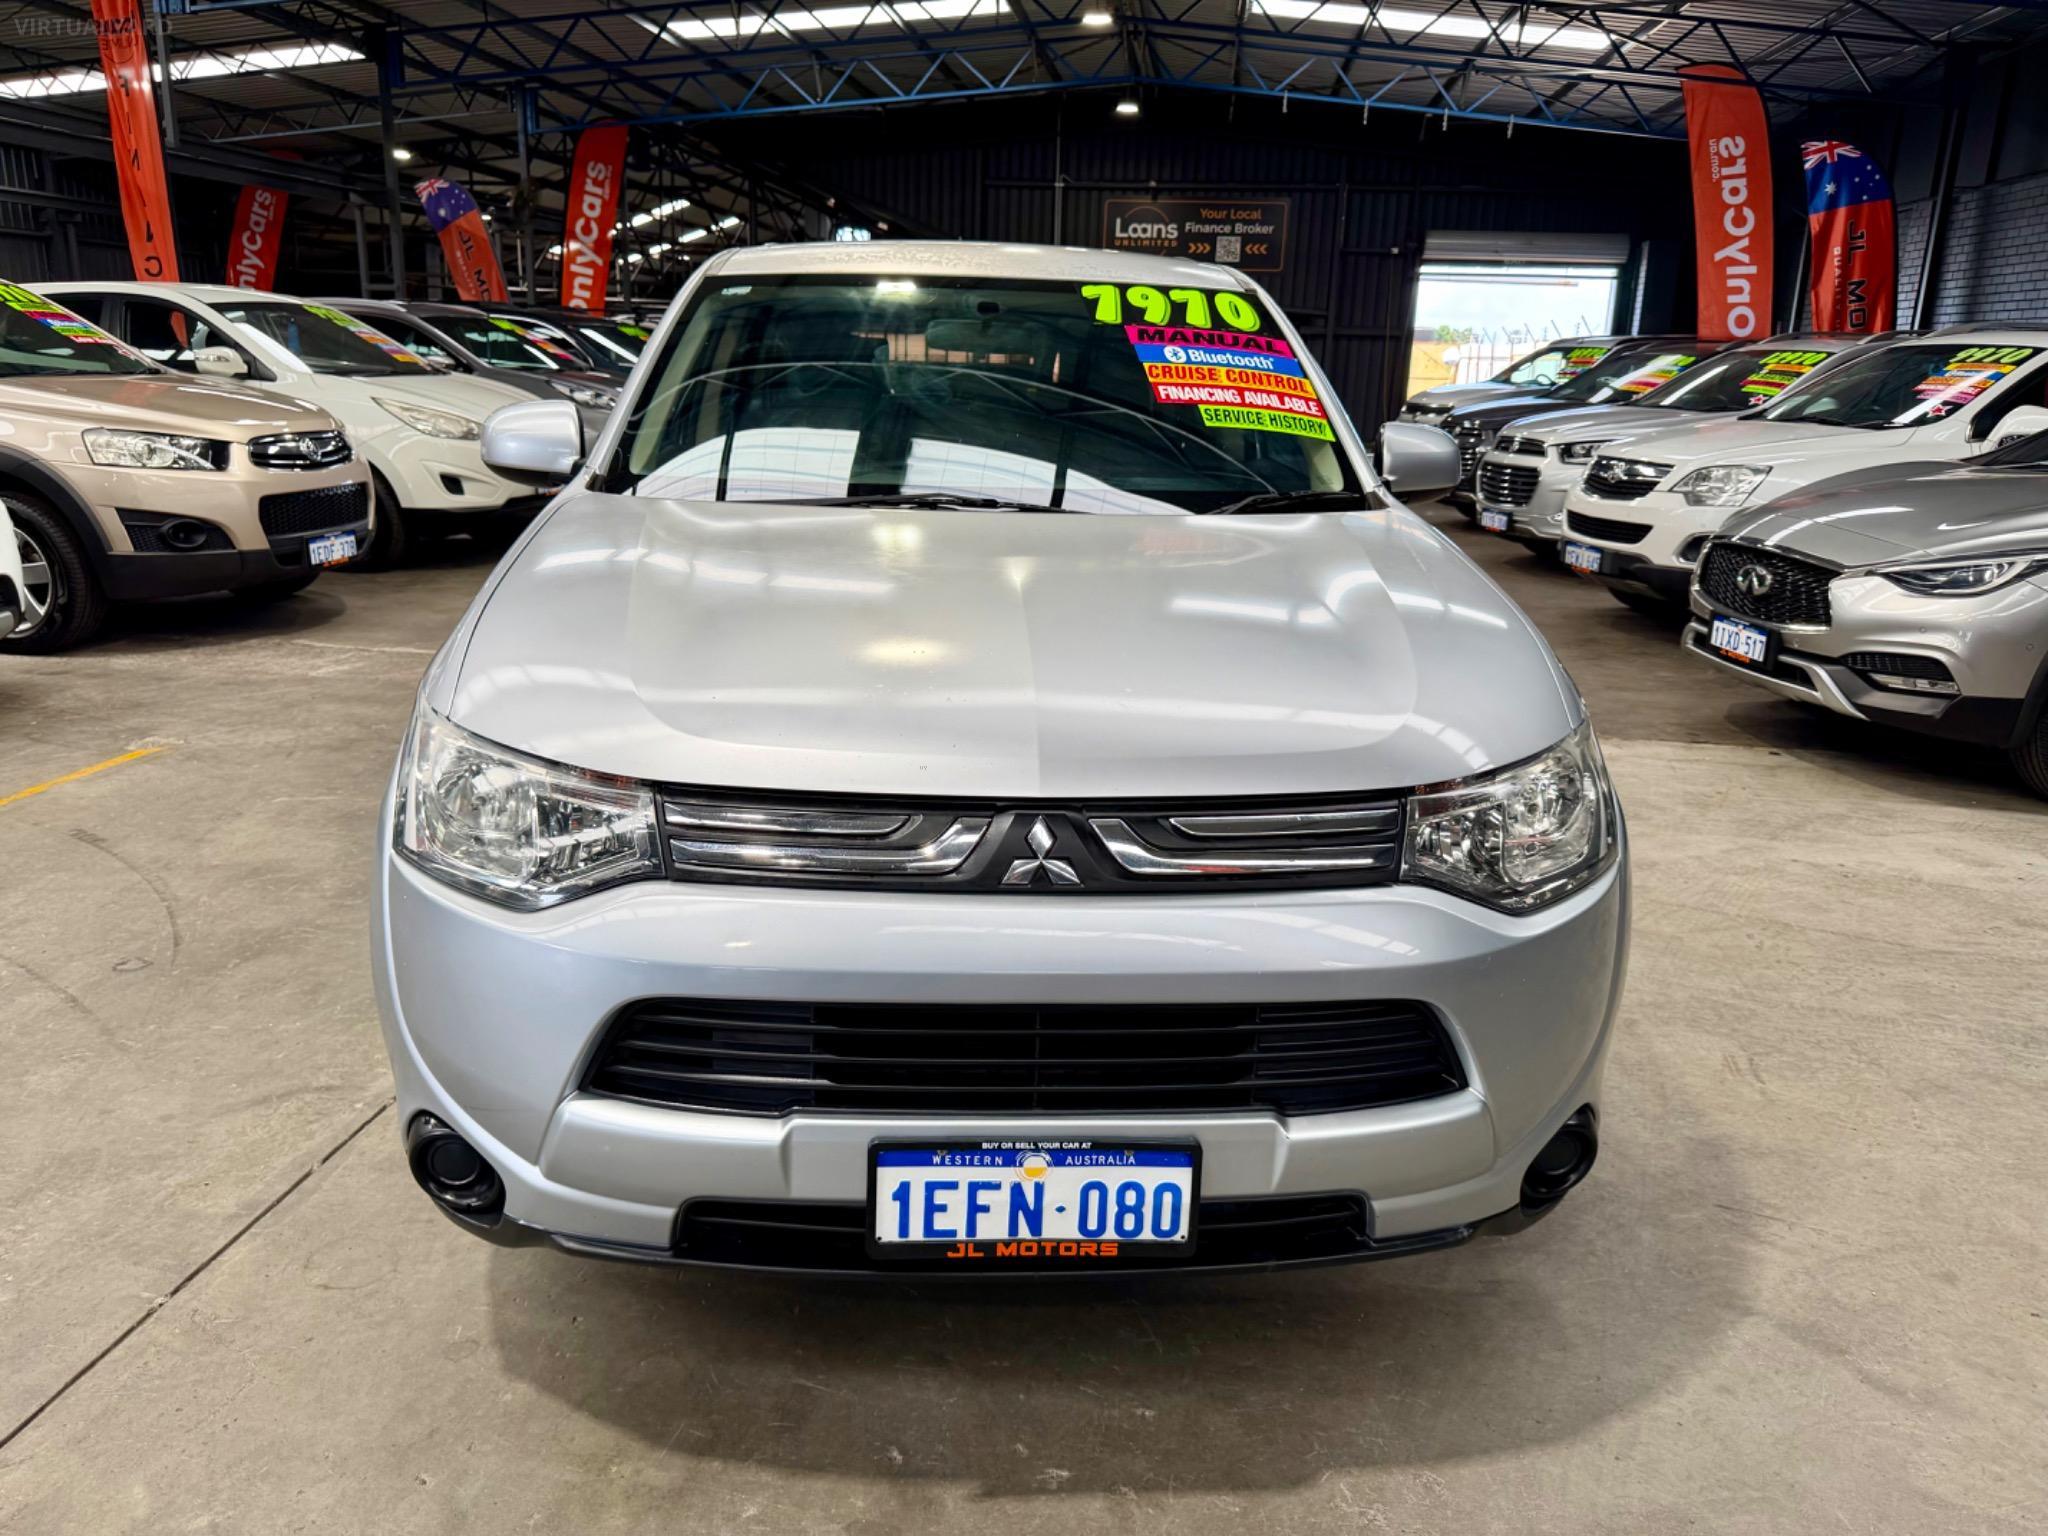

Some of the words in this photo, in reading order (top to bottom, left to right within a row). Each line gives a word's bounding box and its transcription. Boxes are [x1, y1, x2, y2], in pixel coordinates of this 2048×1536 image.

[1200, 208, 1228, 220] Your
[1230, 208, 1262, 220] Local
[1115, 217, 1179, 239] Loans
[1185, 222, 1232, 234] Finance
[1234, 222, 1275, 235] Broker
[1114, 239, 1179, 247] UNLIMITED
[1081, 284, 1261, 332] 7970
[1137, 327, 1285, 355] MANUAL
[1187, 349, 1273, 370] Bluetooth
[1147, 364, 1219, 382] CRUISE
[1225, 369, 1310, 394] CONTROL
[1158, 384, 1241, 404] FINANCING
[1243, 390, 1323, 417] AVAILABLE
[1203, 407, 1264, 425] SERVICE
[982, 1141, 998, 1150] BUY
[1001, 1141, 1013, 1150] OR
[1014, 1141, 1036, 1150] SELL
[1037, 1141, 1061, 1150] YOUR
[1062, 1141, 1079, 1150] CAR
[1080, 1141, 1093, 1150] AT
[932, 1154, 1003, 1166] WESTERN
[1065, 1154, 1136, 1166] AUSTRALIA
[947, 1243, 984, 1259] JL
[996, 1242, 1119, 1258] MOTORS
